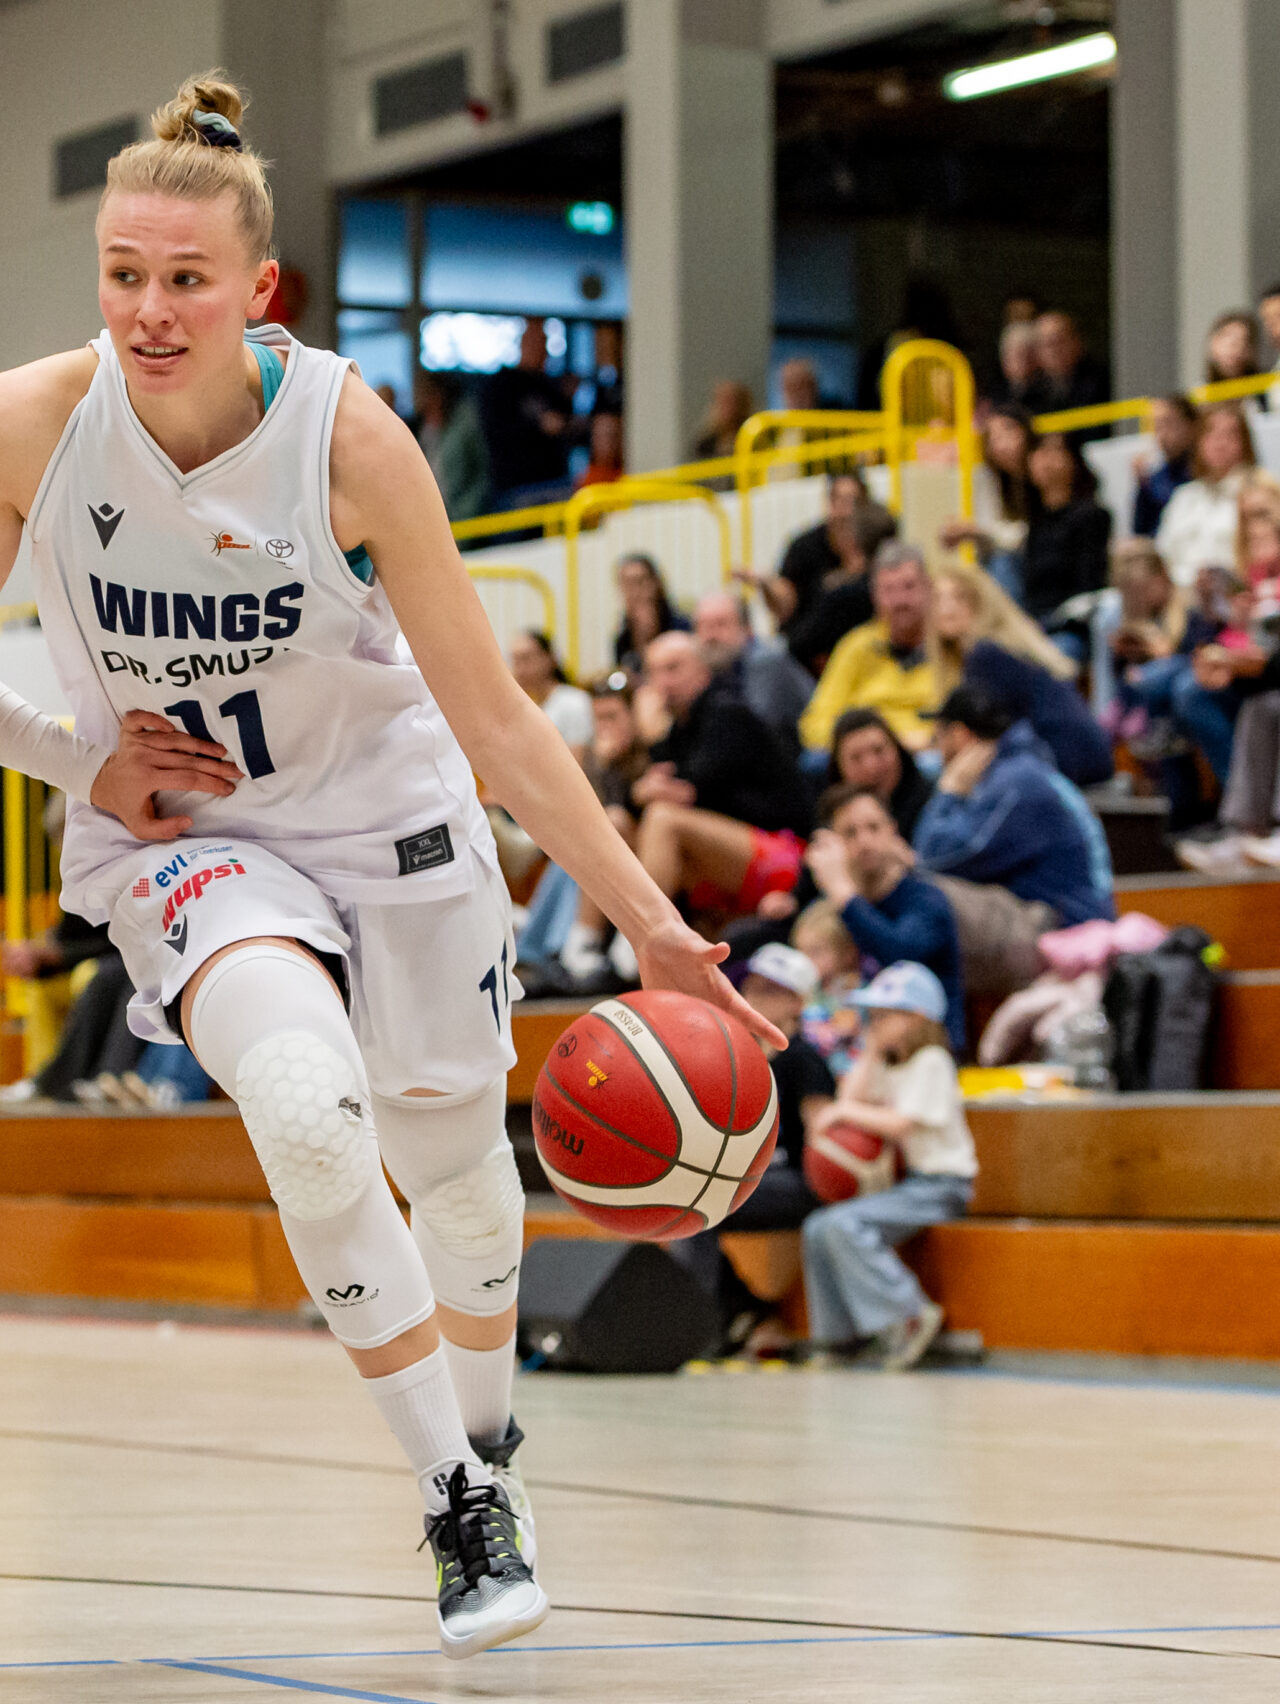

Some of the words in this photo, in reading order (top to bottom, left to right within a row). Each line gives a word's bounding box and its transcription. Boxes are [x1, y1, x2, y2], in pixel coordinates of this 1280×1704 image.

[89, 572, 304, 642] WINGS
[163, 689, 276, 780] 11
[155, 853, 189, 888] evl
